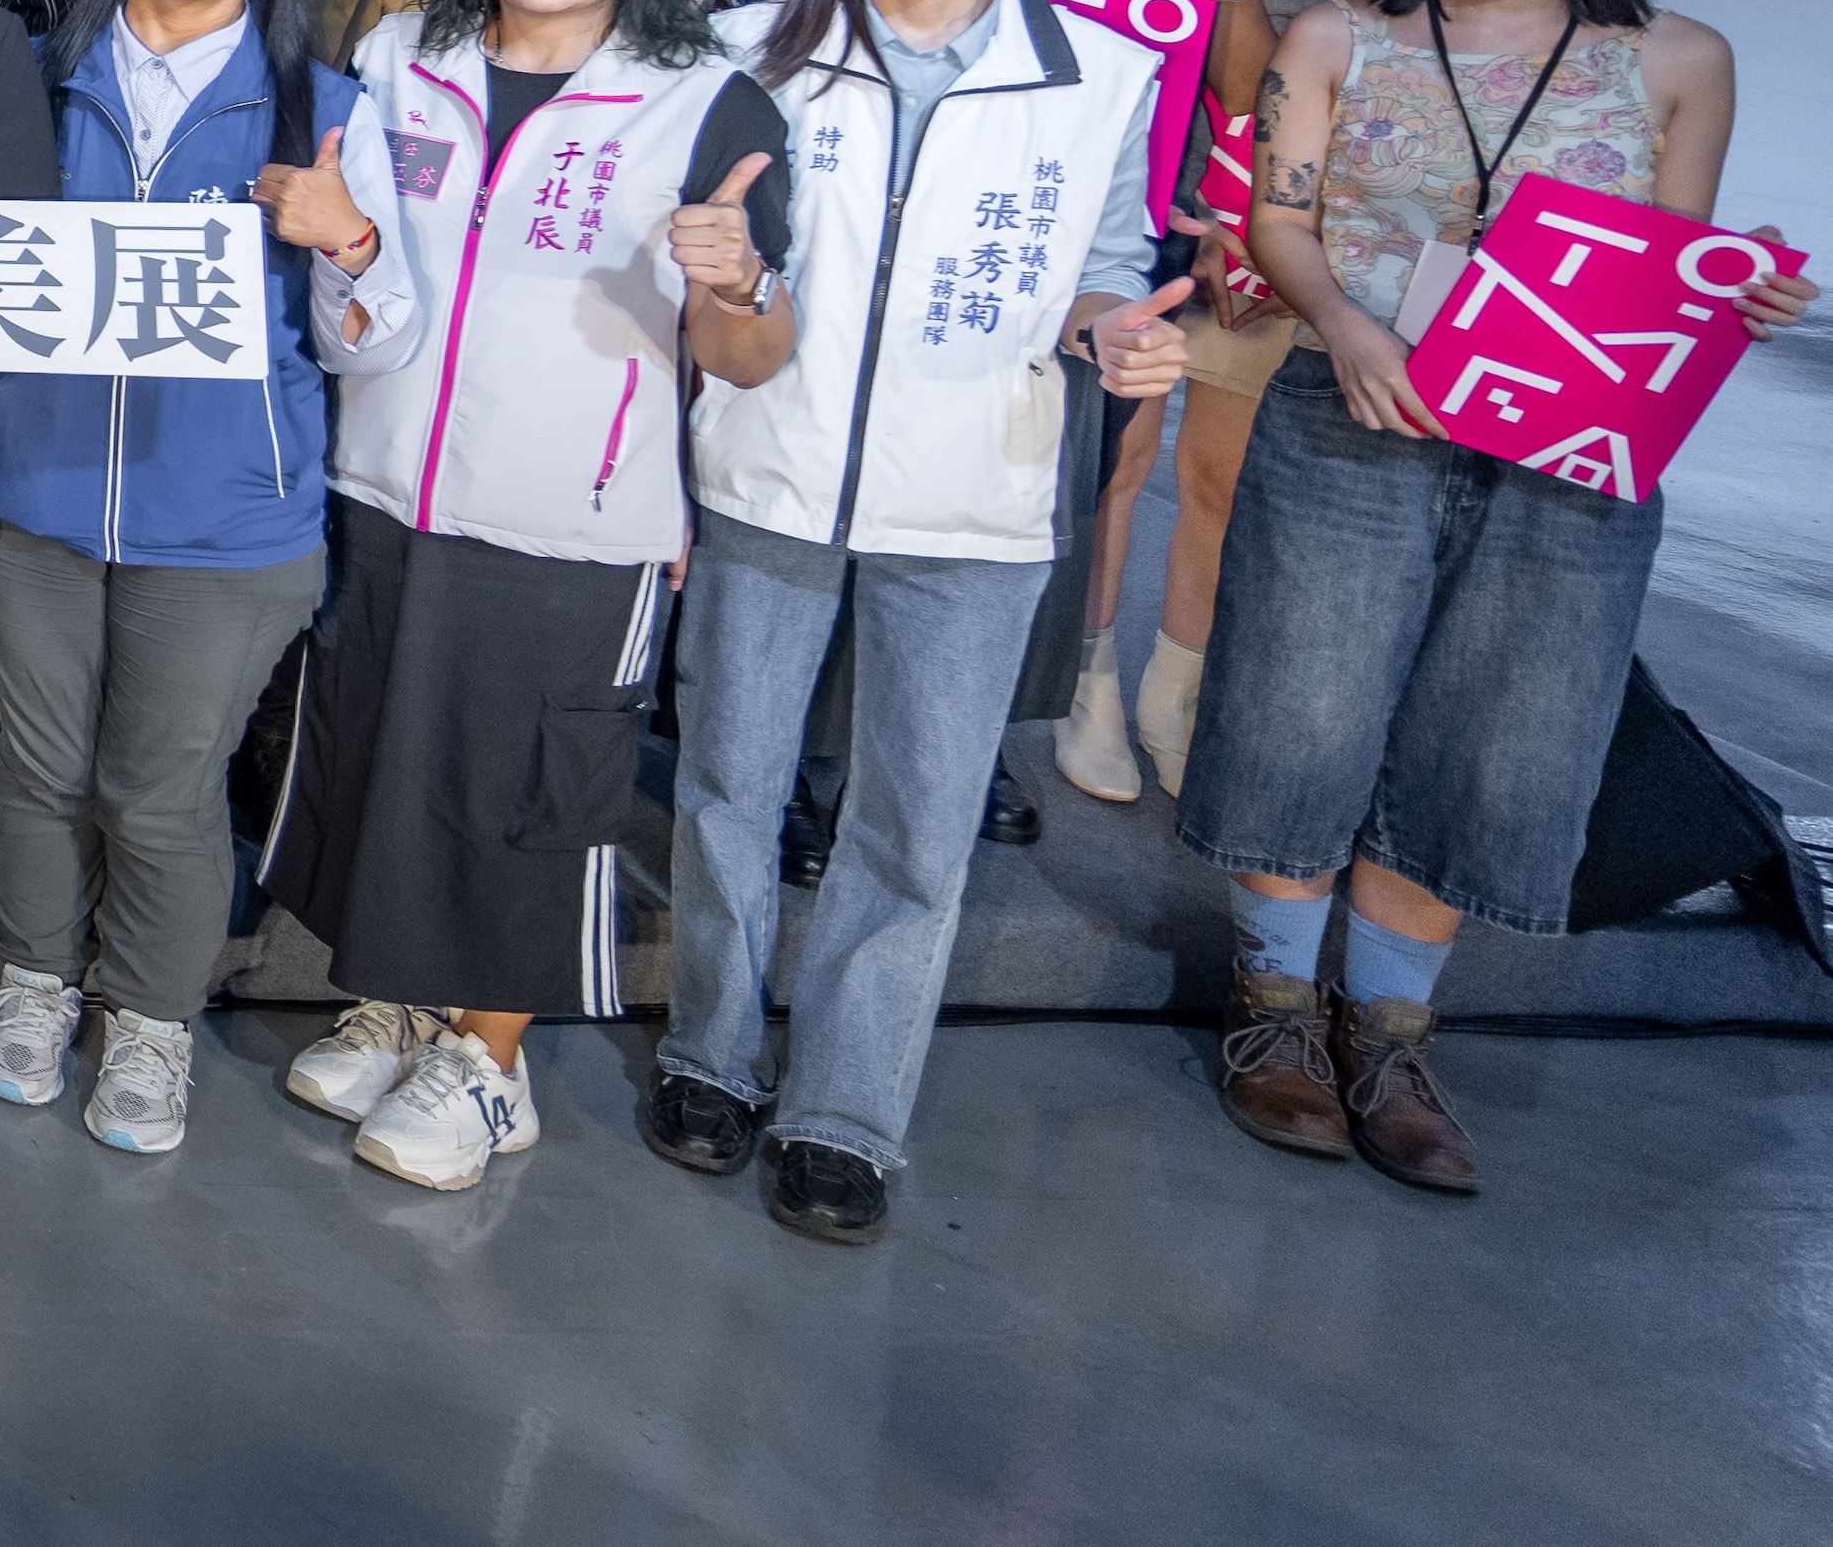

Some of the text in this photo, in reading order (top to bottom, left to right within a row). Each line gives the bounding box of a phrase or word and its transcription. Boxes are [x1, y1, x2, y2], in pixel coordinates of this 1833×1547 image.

[525, 142, 585, 251] 于北辰
[574, 139, 622, 254] 桃園市議員
[810, 126, 844, 172] 特助
[957, 192, 1022, 334] 張秀菊
[1015, 156, 1065, 297] 桃園市議員
[923, 257, 960, 345] 服務團隊
